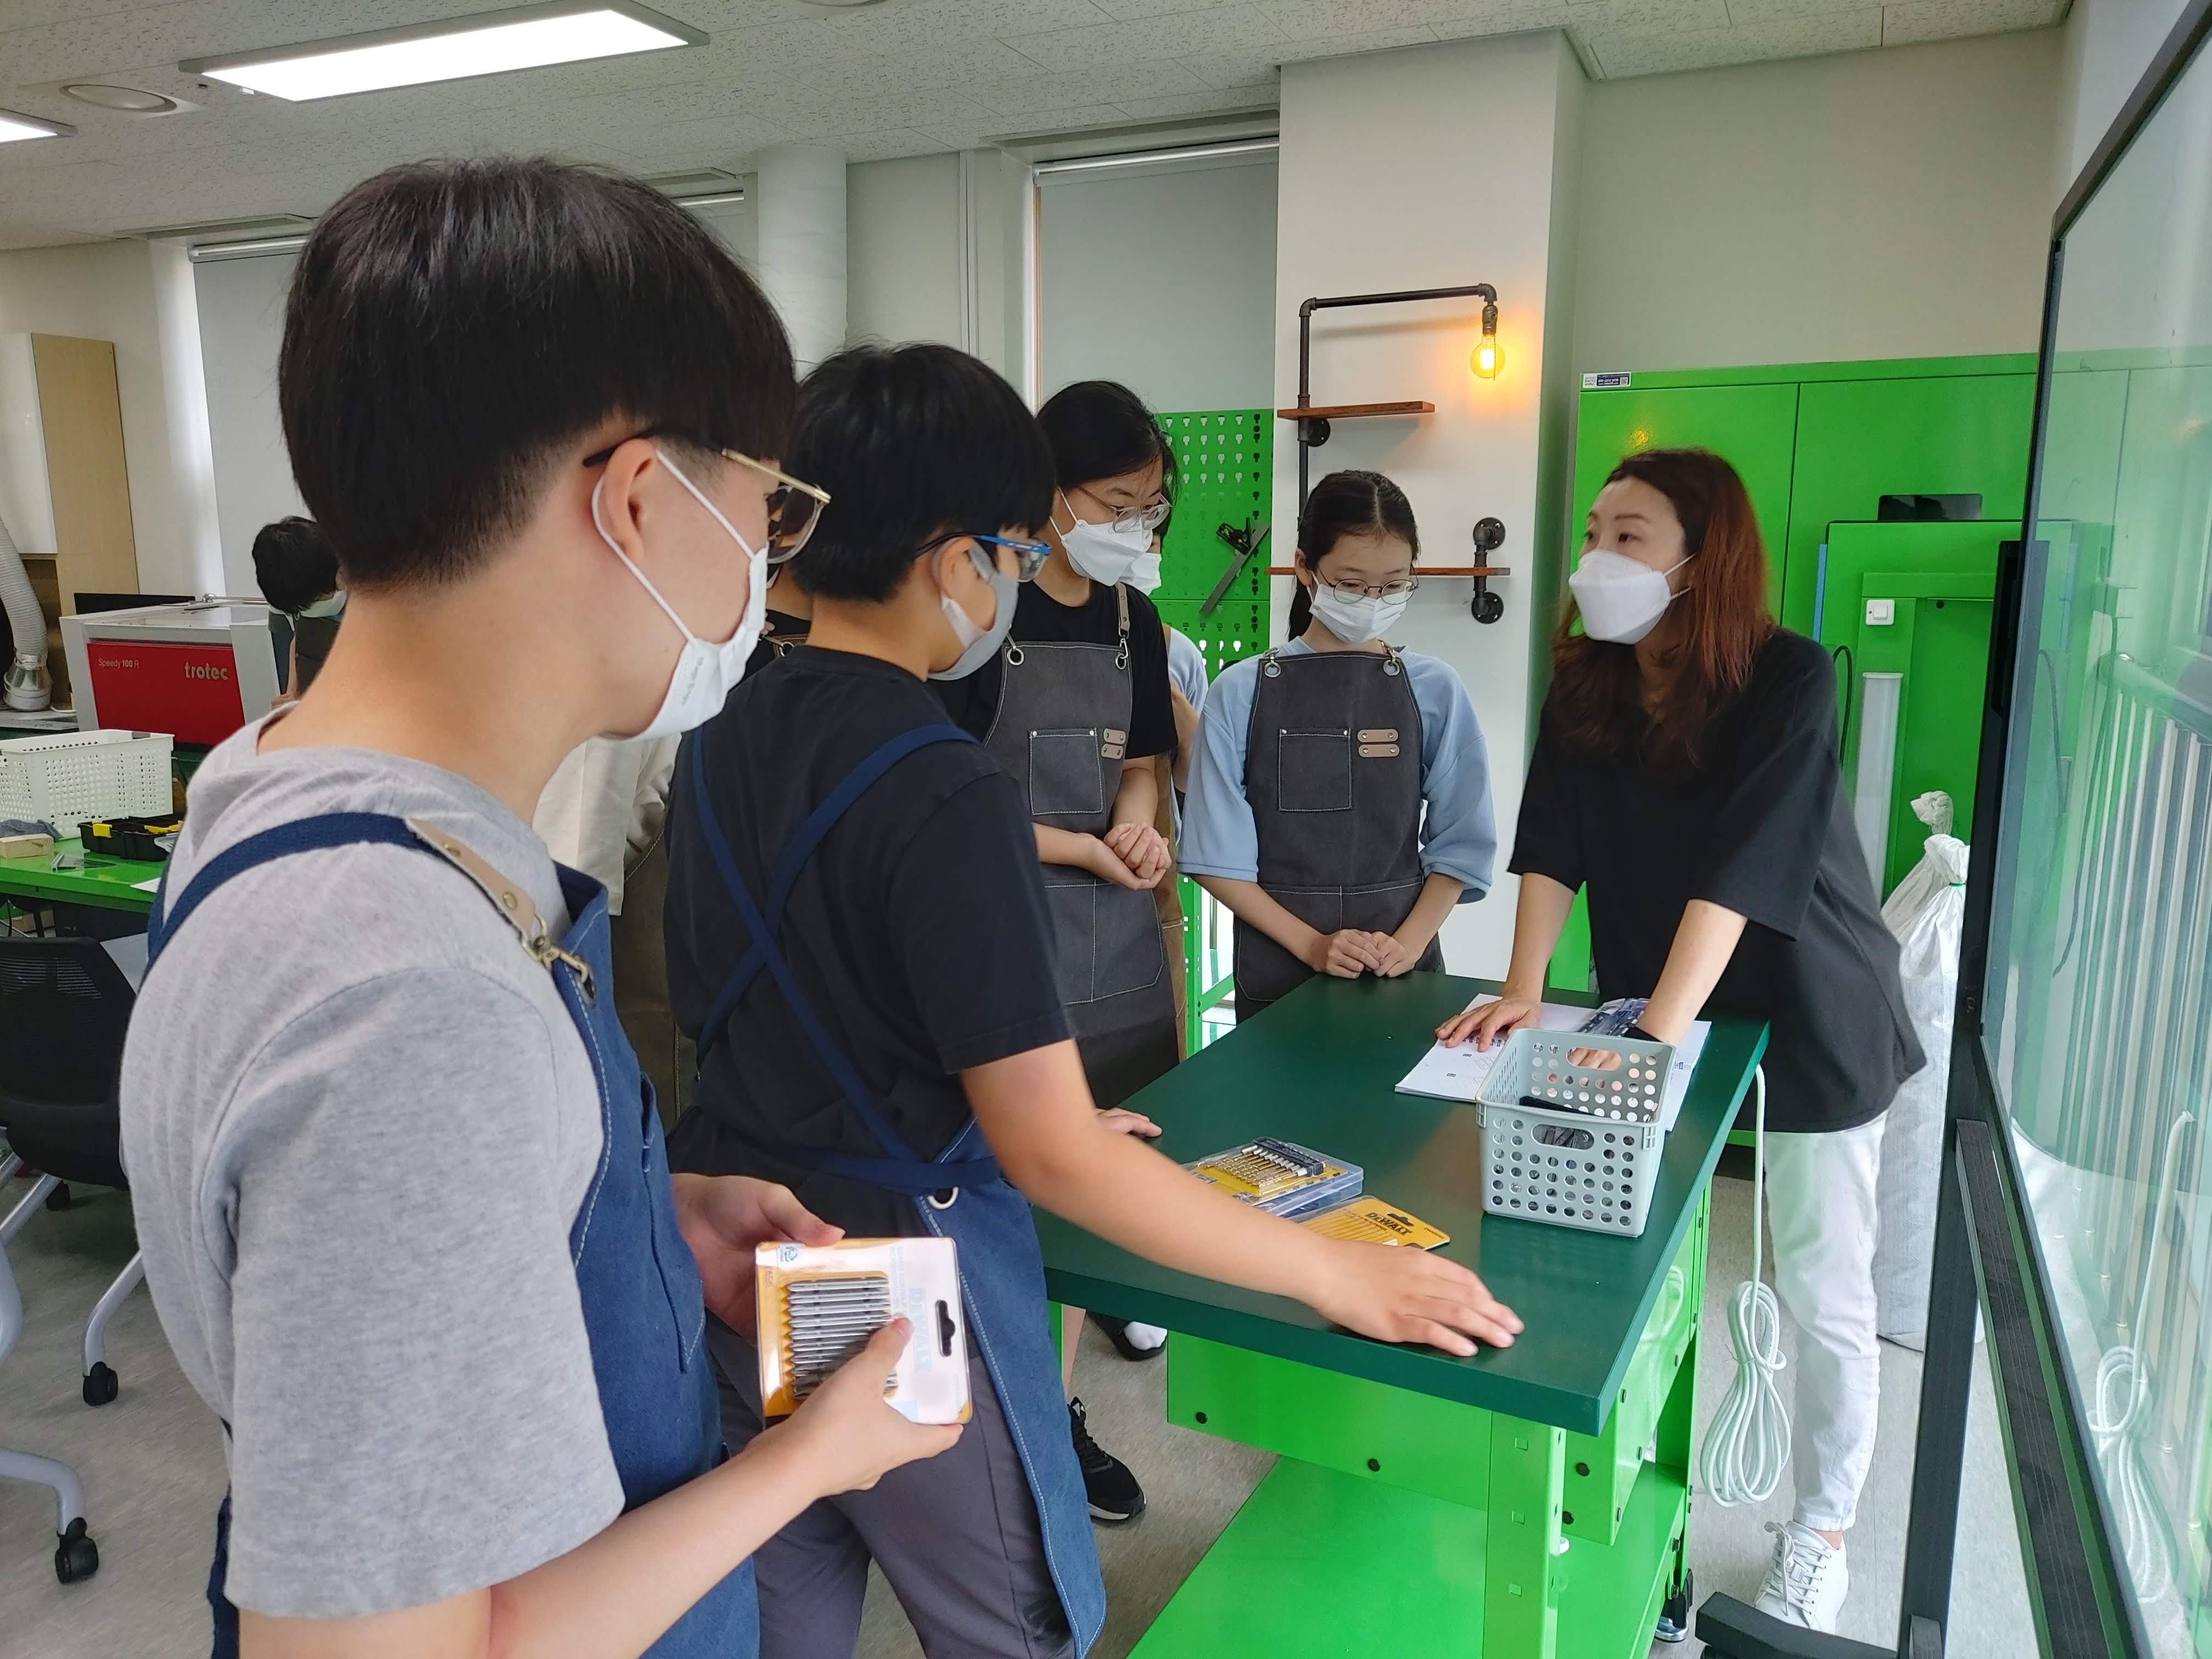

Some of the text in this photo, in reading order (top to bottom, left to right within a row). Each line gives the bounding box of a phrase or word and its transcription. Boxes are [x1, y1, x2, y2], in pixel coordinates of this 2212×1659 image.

[98, 658, 140, 669] Speedy 100 R
[184, 662, 229, 681] trotec
